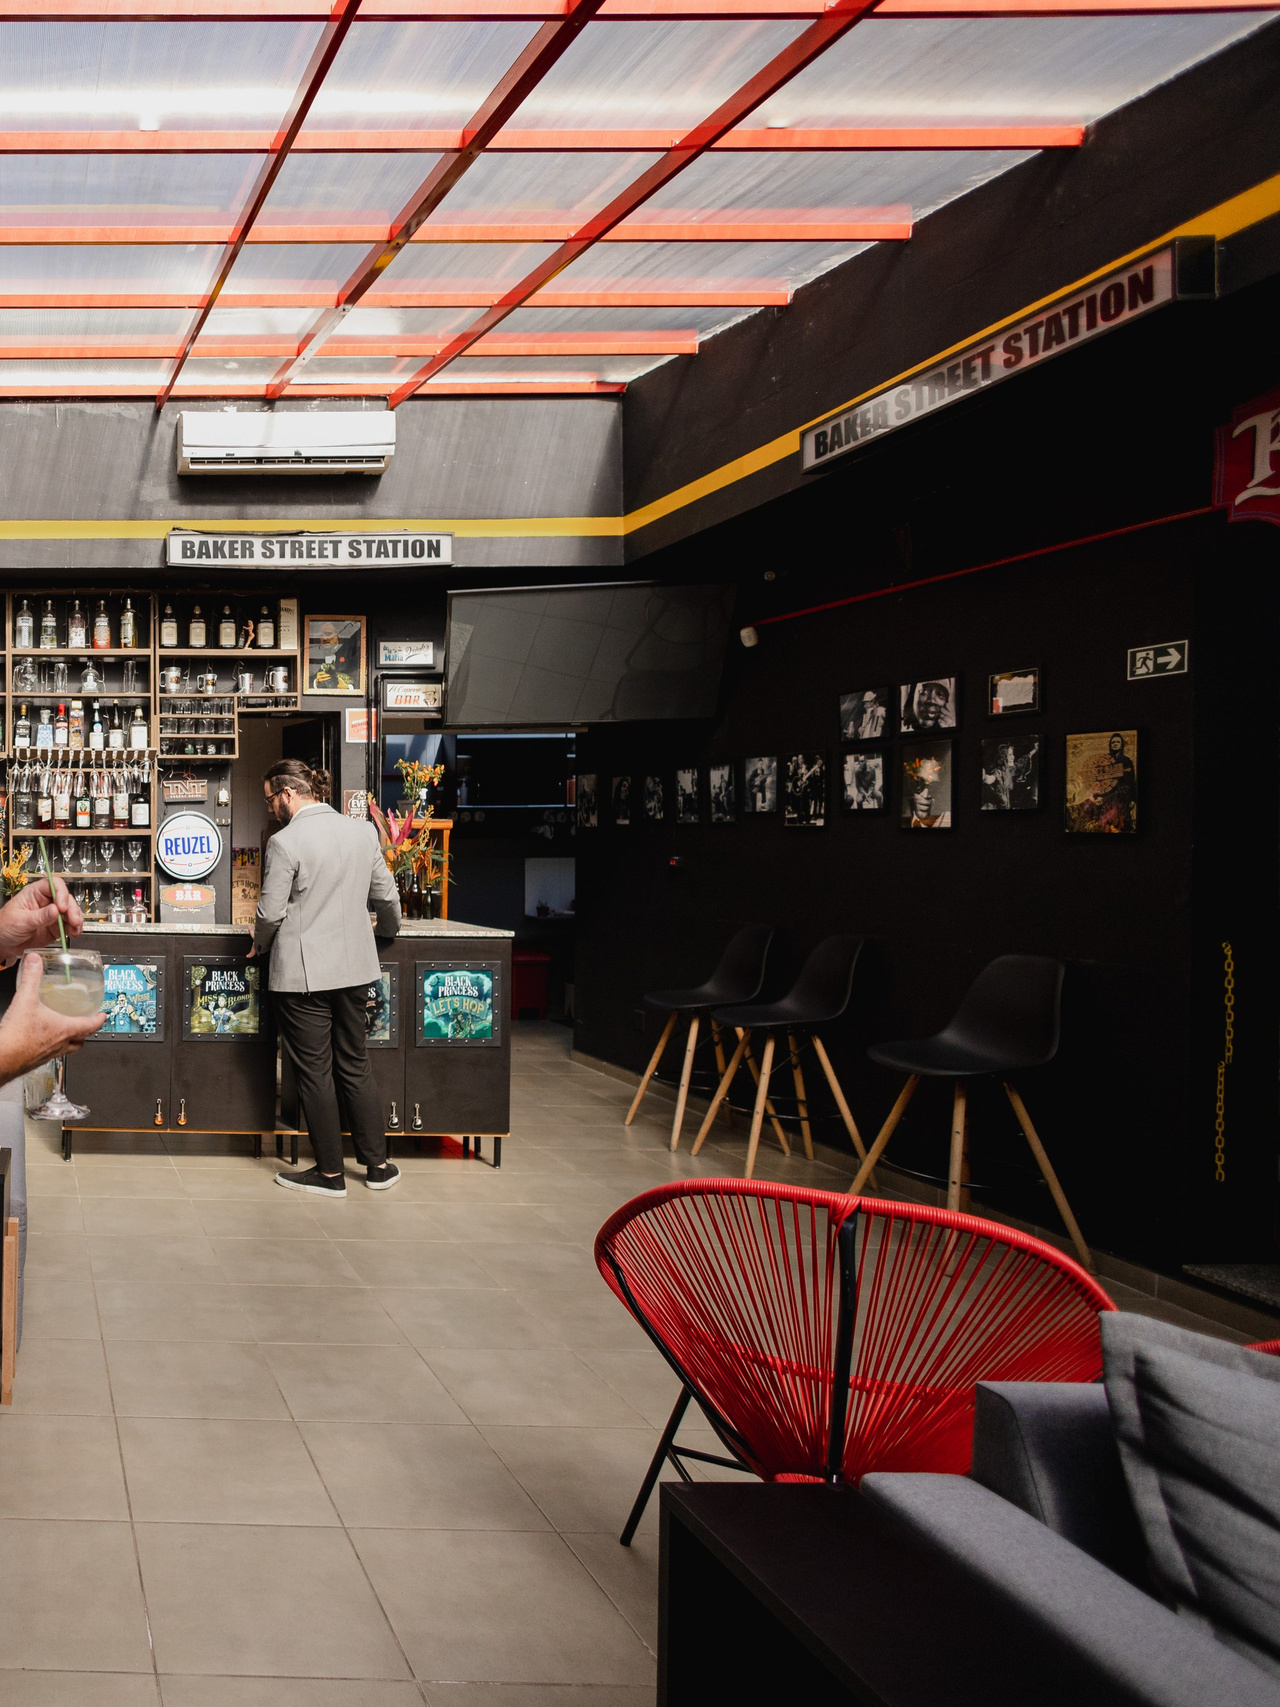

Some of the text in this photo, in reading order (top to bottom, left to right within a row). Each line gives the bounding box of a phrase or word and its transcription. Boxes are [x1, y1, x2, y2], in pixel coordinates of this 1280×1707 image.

[815, 265, 1154, 460] BAKER STREET STATION
[181, 539, 441, 559] BAKER STREET STATION
[394, 695, 420, 705] BAR
[163, 780, 207, 794] TNT
[164, 836, 213, 856] REUZEL
[175, 890, 202, 901] BAR
[108, 970, 136, 981] BLACK
[212, 971, 238, 982] BLACK
[205, 981, 245, 992] PRINCESS
[445, 976, 471, 987] BLACK
[438, 986, 478, 997] PRINCESS
[196, 995, 218, 1008] MISS
[432, 998, 484, 1014] LET'S HOP
